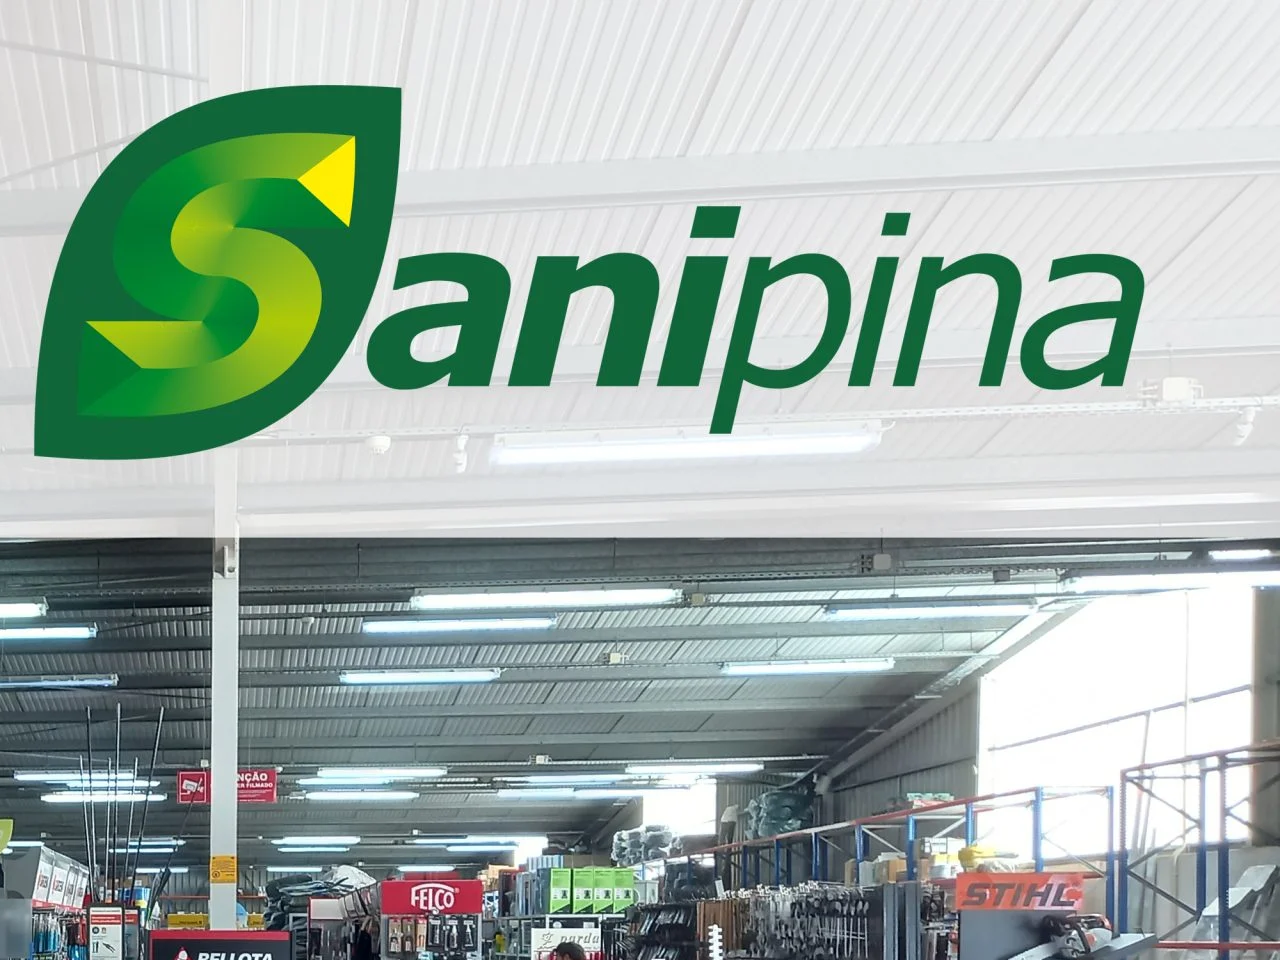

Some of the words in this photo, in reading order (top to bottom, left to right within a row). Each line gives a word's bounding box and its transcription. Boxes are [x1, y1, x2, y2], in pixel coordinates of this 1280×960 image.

[245, 782, 274, 790] FILMADO
[410, 882, 455, 915] FELCO
[961, 882, 1076, 908] STIHL
